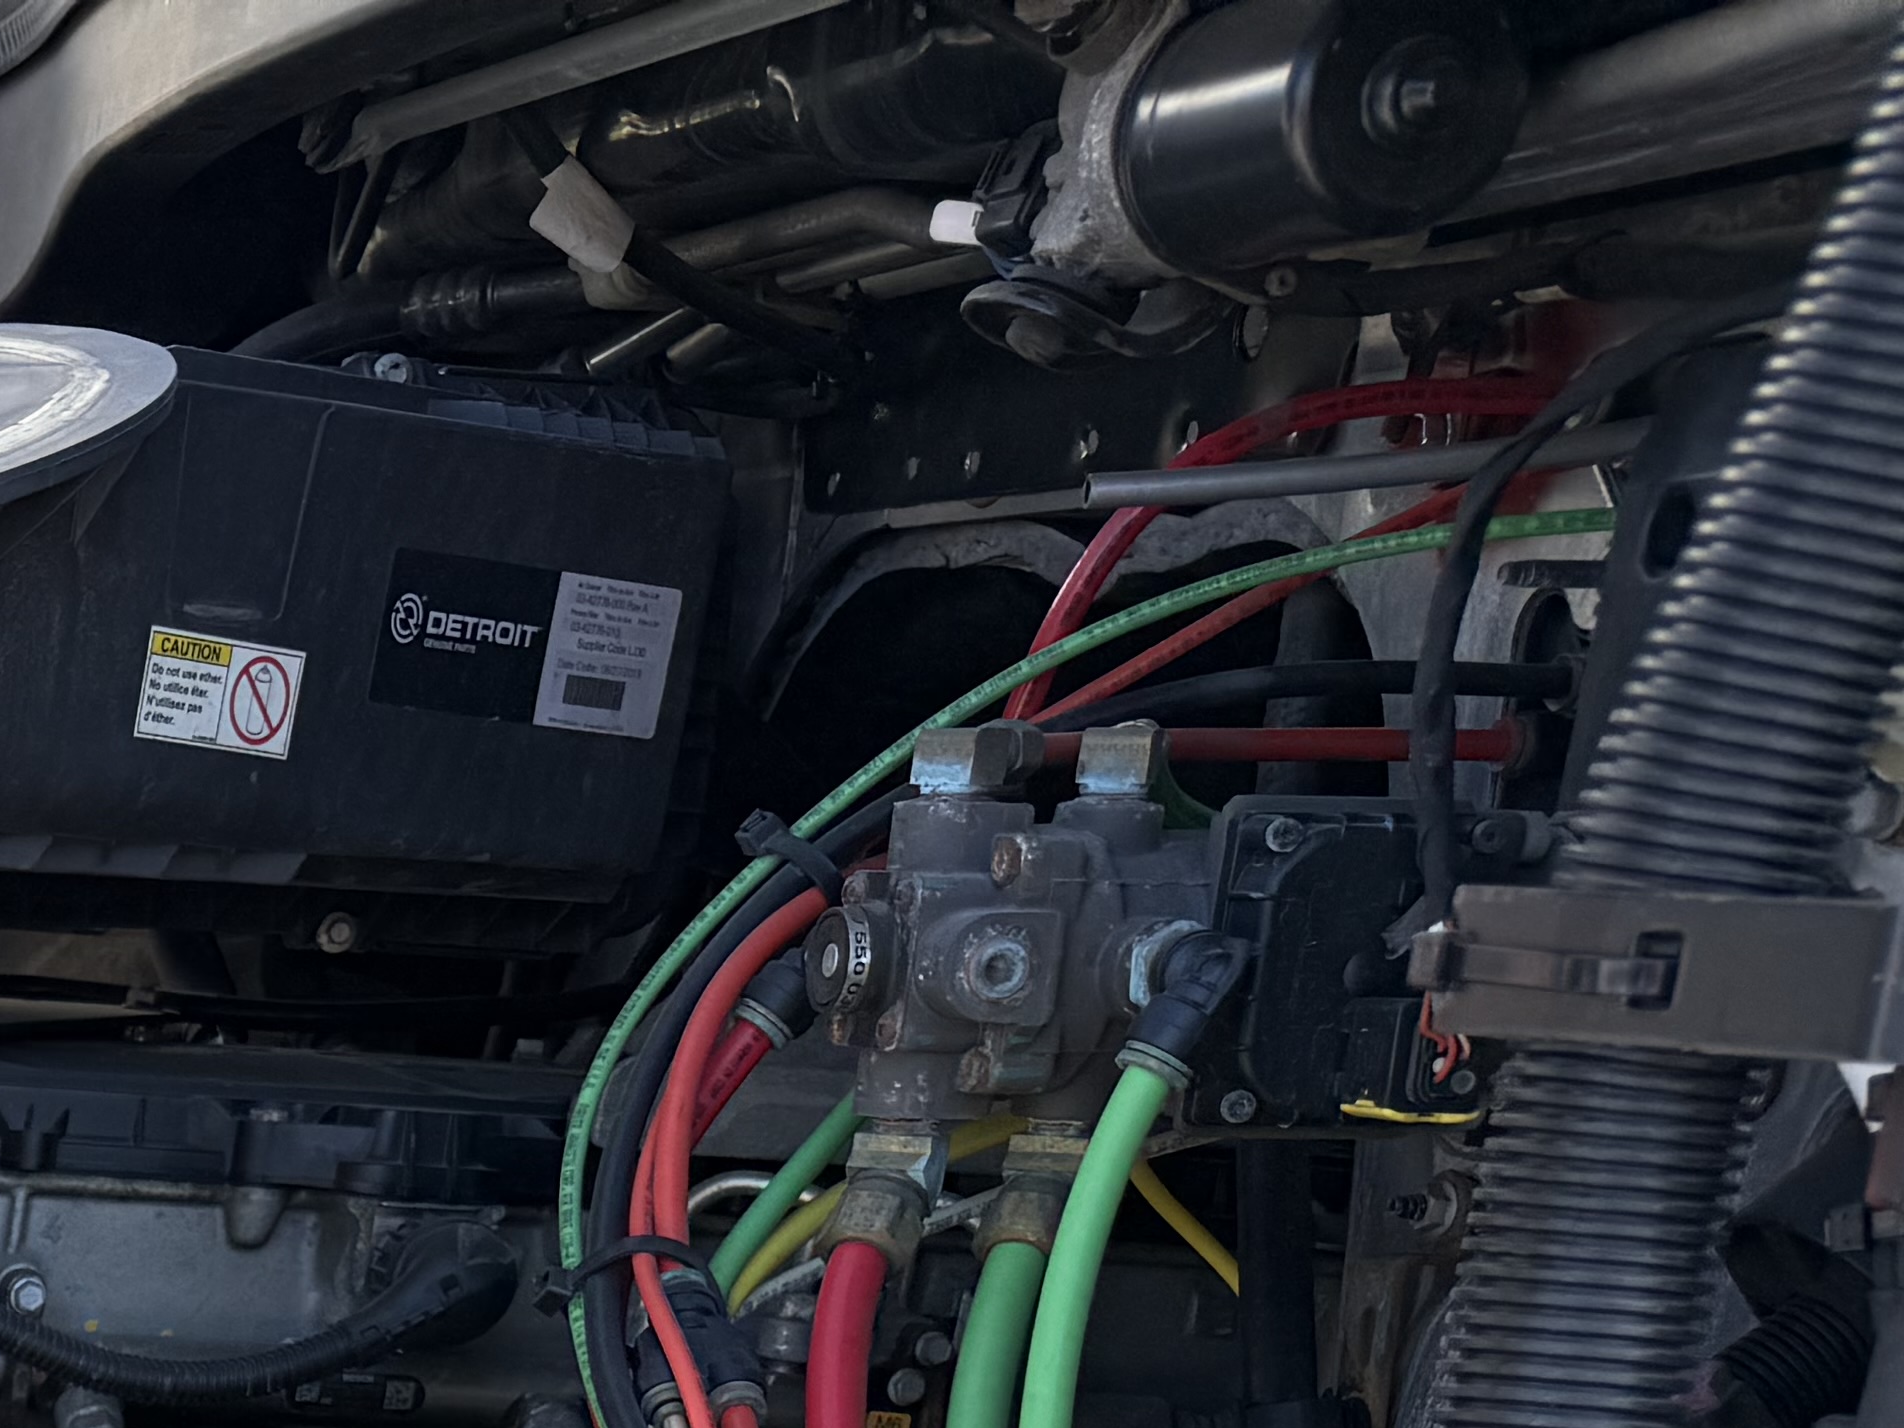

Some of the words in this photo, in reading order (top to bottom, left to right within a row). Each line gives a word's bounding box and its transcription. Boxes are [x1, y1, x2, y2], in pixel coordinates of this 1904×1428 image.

[426, 610, 539, 648] DETROIT
[161, 637, 222, 662] CAUTION
[152, 663, 164, 675] Do
[182, 671, 198, 680] use
[149, 680, 161, 690] No
[854, 932, 866, 975] 550
